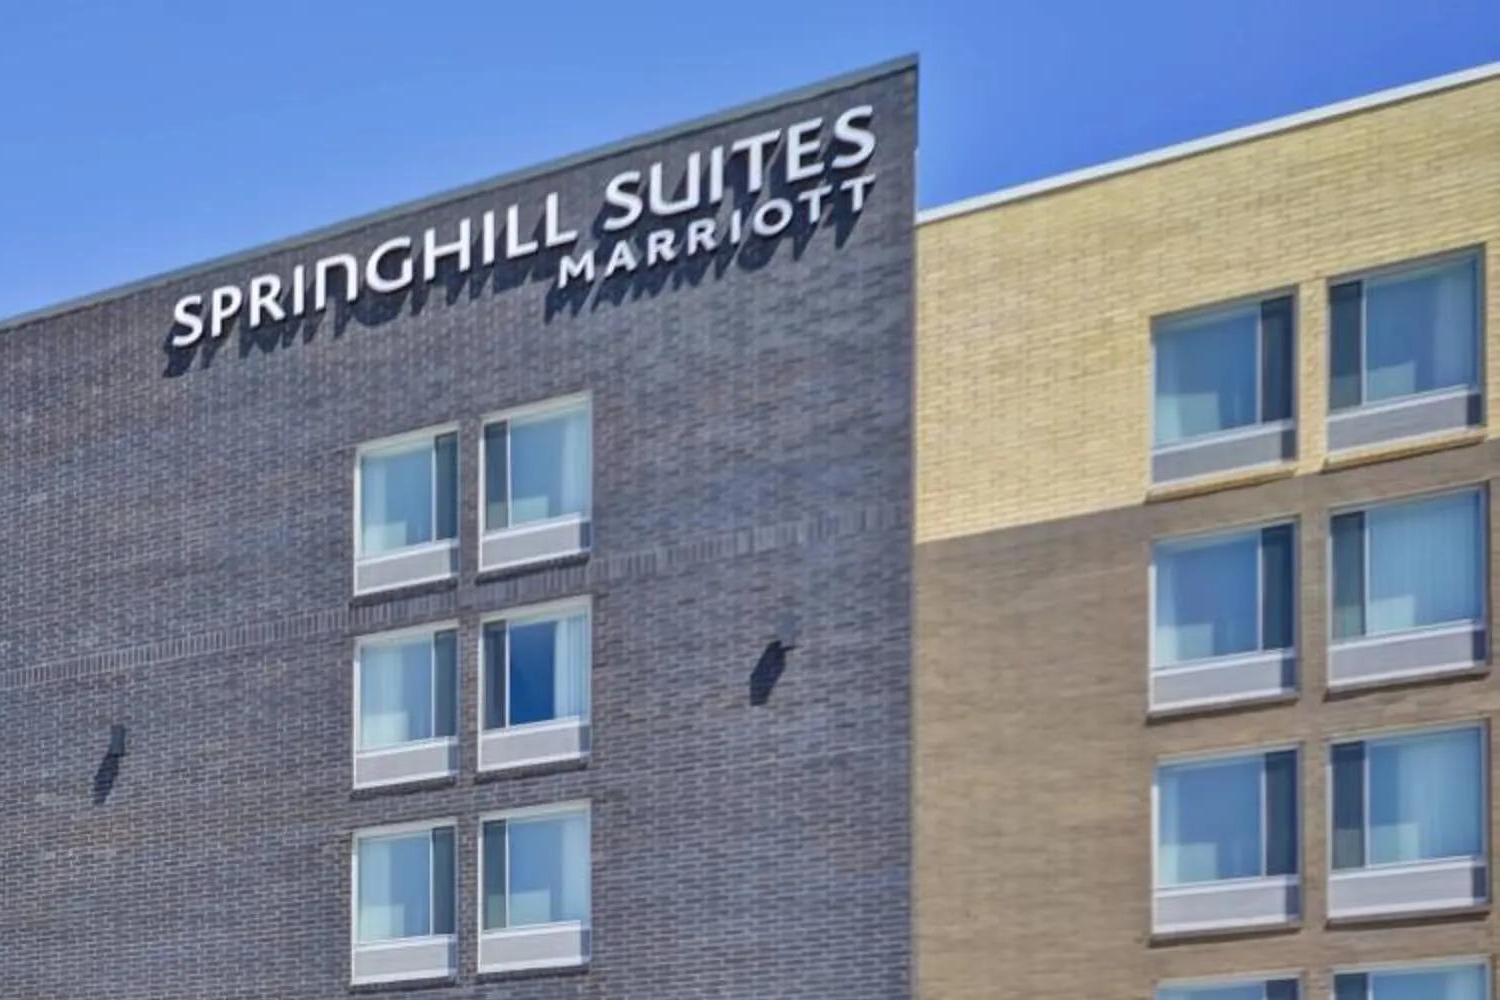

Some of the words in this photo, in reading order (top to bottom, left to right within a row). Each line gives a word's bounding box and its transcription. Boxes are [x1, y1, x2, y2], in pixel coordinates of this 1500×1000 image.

[171, 191, 579, 348] SPRINGHILL
[603, 104, 877, 232] SUITES
[558, 175, 877, 290] MARRIOTT
